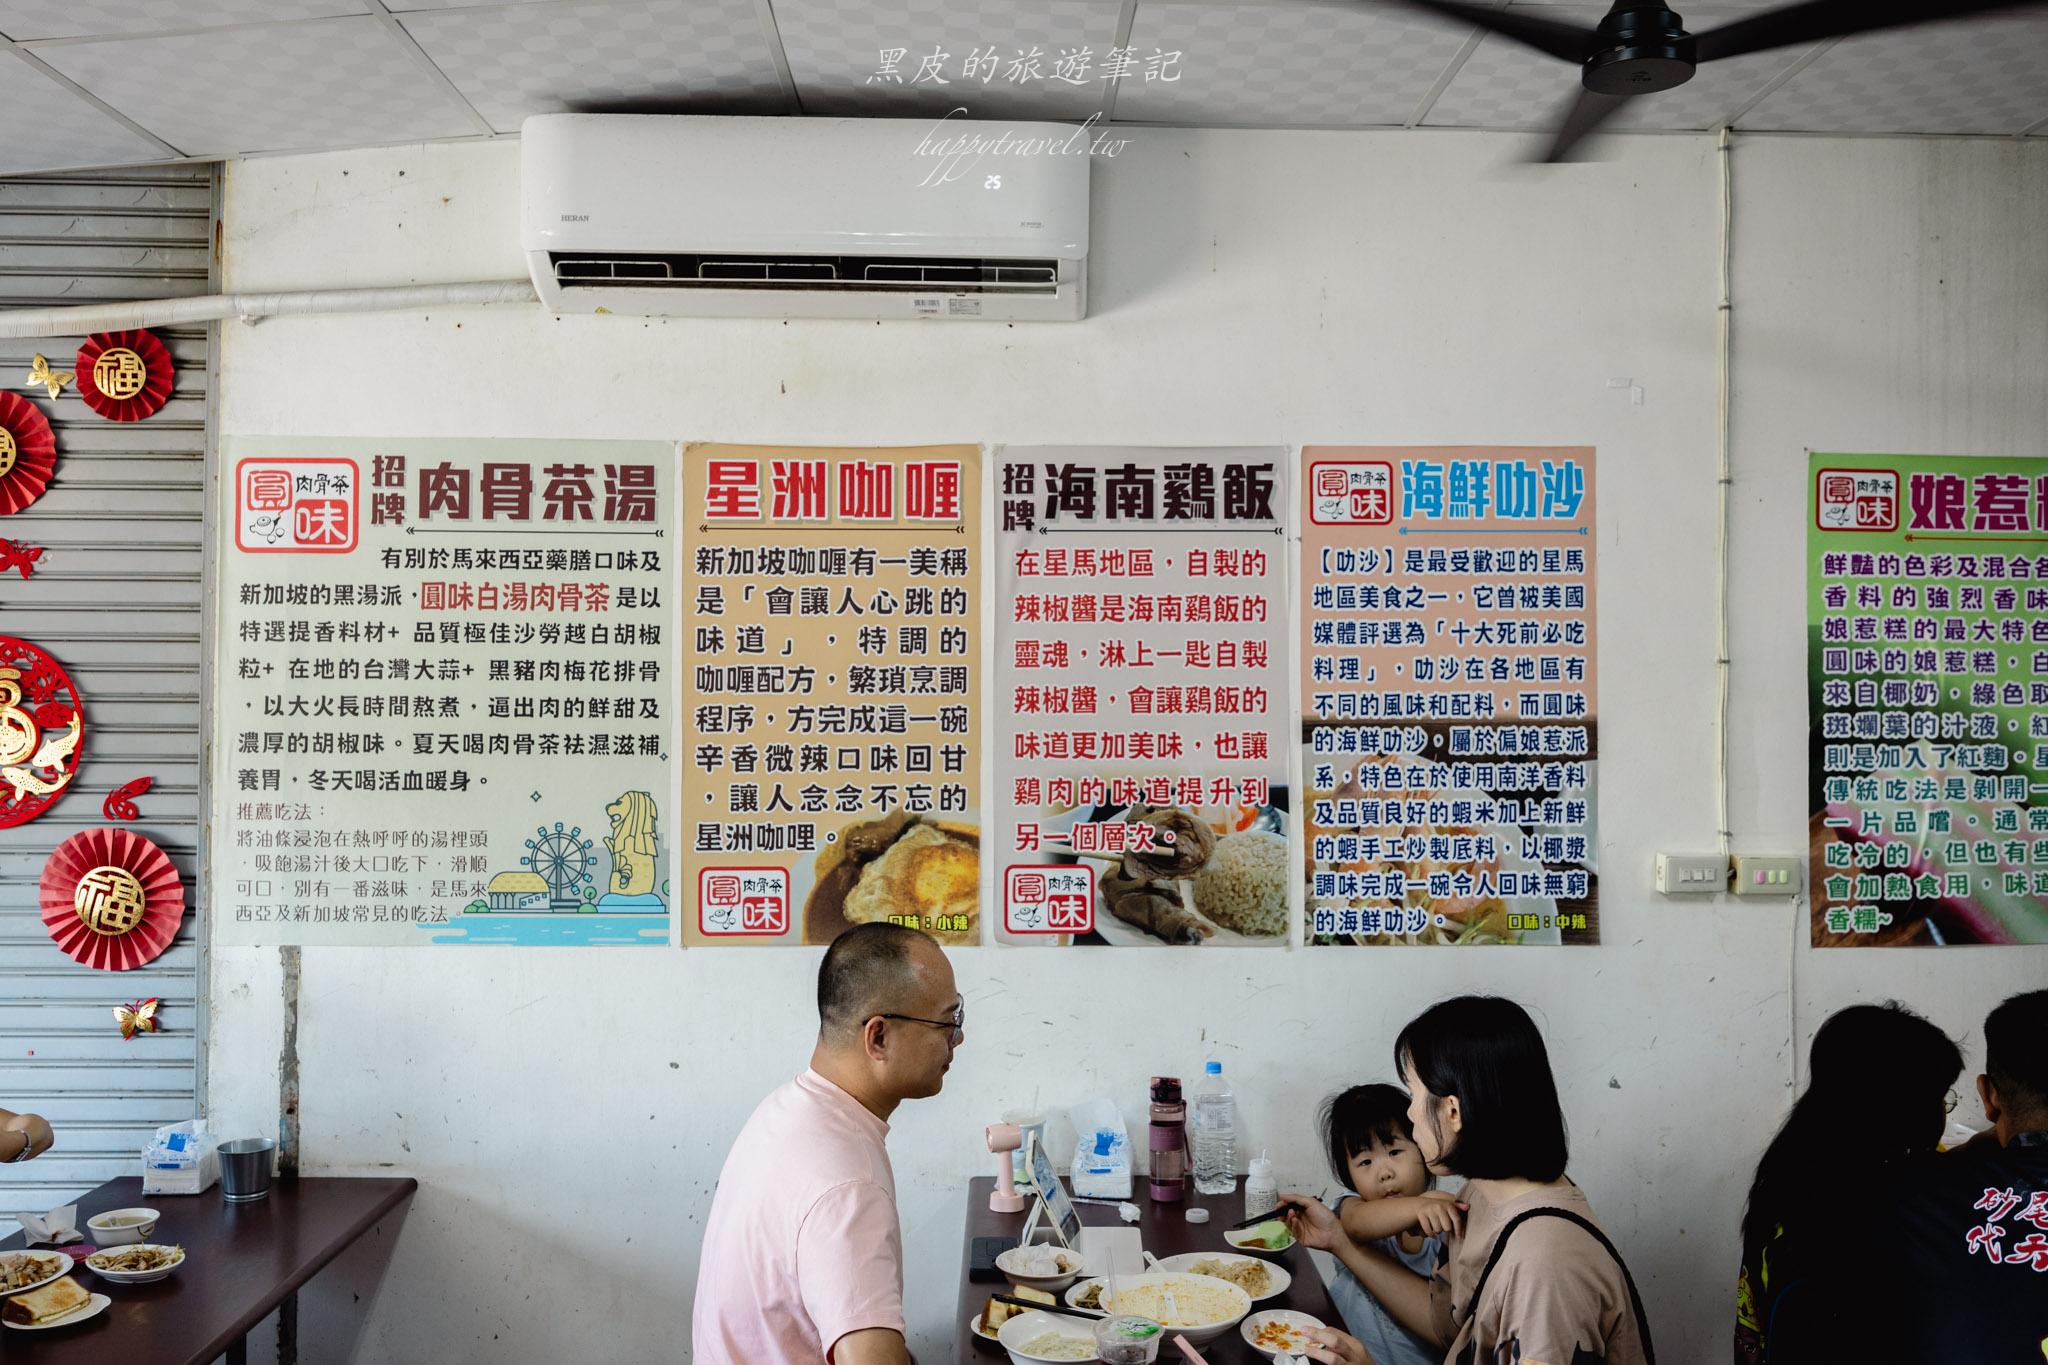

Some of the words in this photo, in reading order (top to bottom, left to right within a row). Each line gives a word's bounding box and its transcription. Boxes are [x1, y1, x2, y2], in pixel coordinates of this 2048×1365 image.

[94, 349, 146, 399] 福
[295, 473, 349, 494] 肉骨茶
[371, 455, 406, 525] 招牌
[418, 461, 658, 523] 肉骨茶湯
[706, 461, 960, 518] 星洲咖喱
[1350, 471, 1387, 486] 肉骨茶
[1402, 461, 1584, 518] 海鮮叻沙
[1003, 463, 1035, 532] 招牌
[1910, 474, 2048, 531] 娘惹
[294, 499, 348, 545] 味
[381, 548, 661, 572] 有別於馬來西亞藥膳口味及
[696, 547, 968, 576] 新加坡咖喱有一美稱
[1015, 549, 1267, 577] 在星馬地區，自製的
[696, 586, 968, 615] 是「會讓人心跳的
[1314, 585, 1584, 609] 地區美食之一，它曾被美國
[1314, 621, 1584, 645] 媒體評選為「十大死前必吃
[1015, 640, 1268, 668] 靈魂，淋上一匙自製
[696, 665, 968, 694] 咖喱配方，繁瑣烹調
[696, 705, 968, 733] 程序，方完成這一碗
[696, 745, 968, 773] 辛香微辣口味回甘
[1014, 732, 1268, 760] 味道更加美味，也讓
[237, 768, 488, 793] 養胃，冬天喝活血暖身。
[236, 802, 326, 822] 推薦吃法：
[1316, 801, 1586, 825] 及品質良好的蝦米加上新鮮
[236, 829, 488, 849] 將油條浸泡在熱呼呼的湯裡頭
[1015, 823, 1177, 852] 另一個層次。
[743, 877, 783, 893] 肉骨茶
[1048, 875, 1087, 891] 肉骨茶
[1316, 873, 1587, 897] 調味完成一碗令人回味無窮
[75, 866, 145, 936] 福
